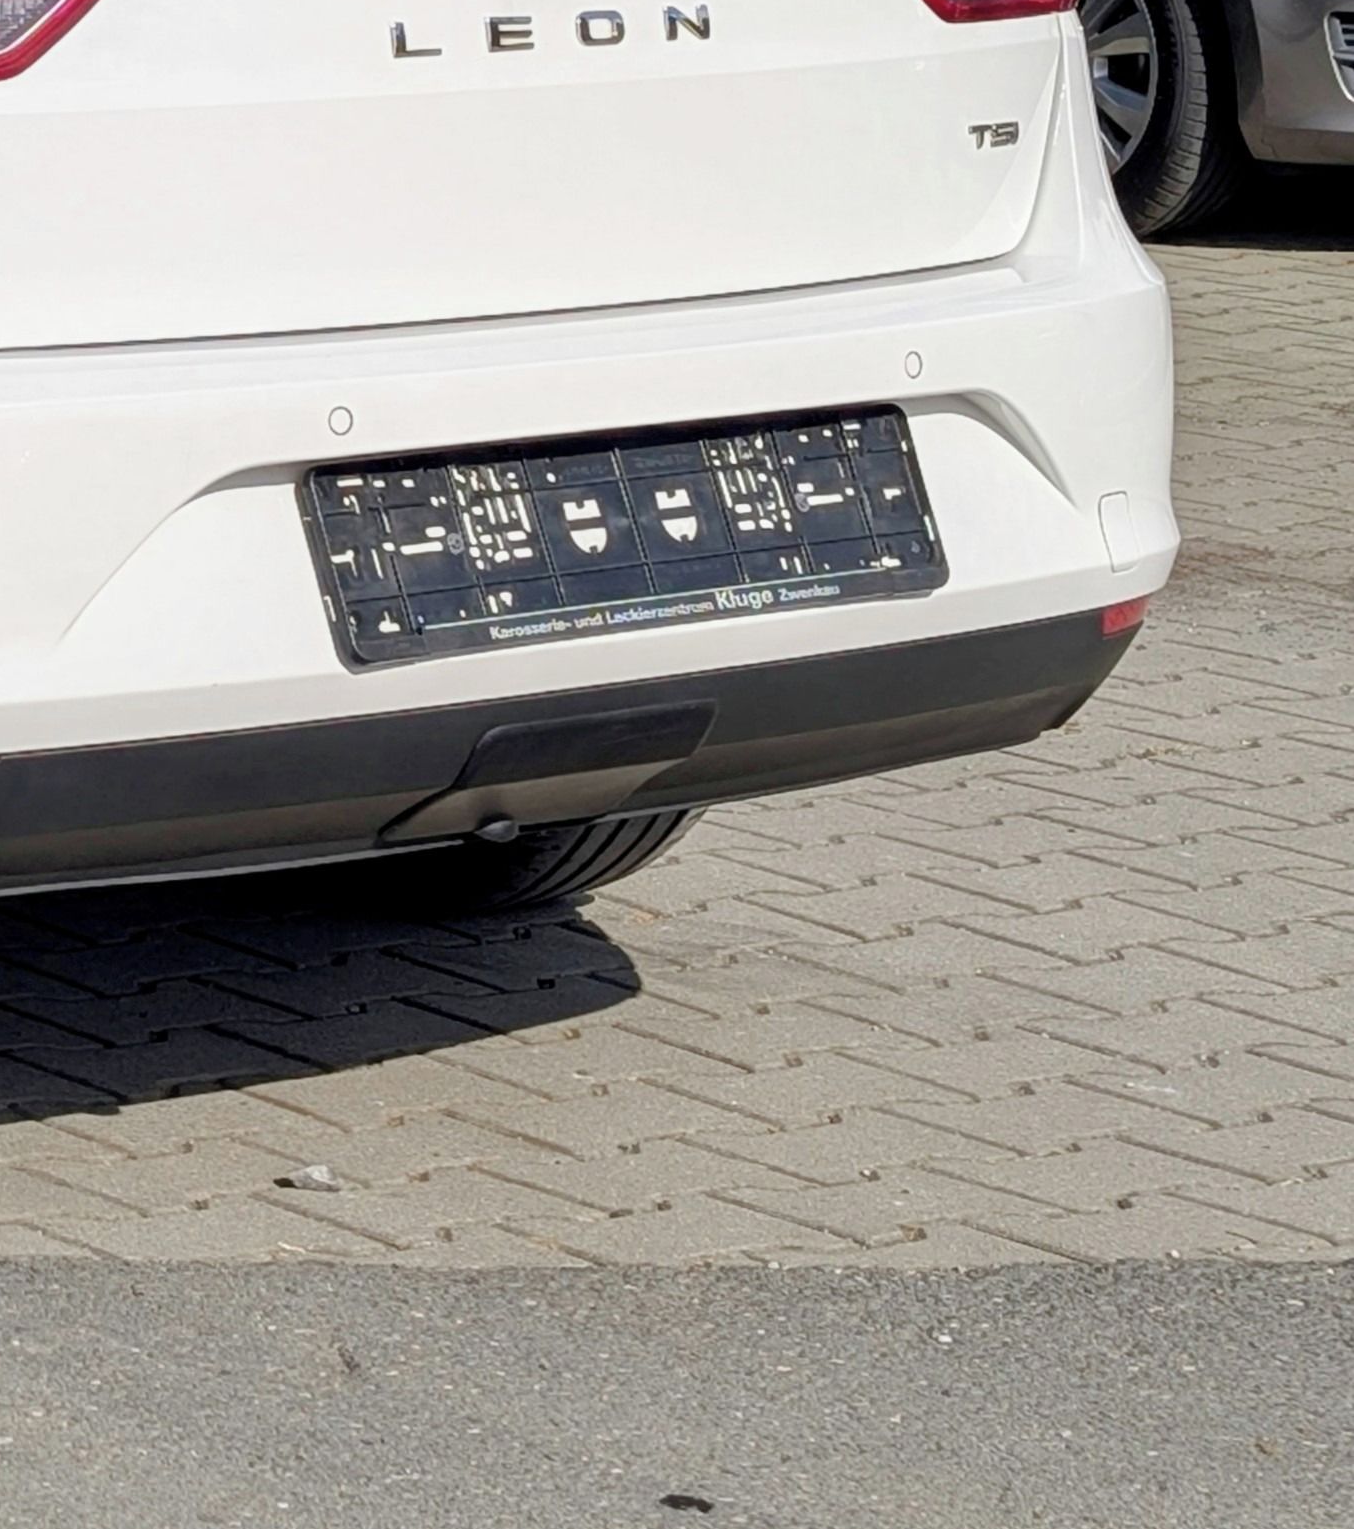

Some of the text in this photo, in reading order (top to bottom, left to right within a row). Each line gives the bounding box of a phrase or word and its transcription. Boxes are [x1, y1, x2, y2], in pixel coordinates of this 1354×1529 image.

[390, 4, 710, 58] LEON
[574, 612, 604, 629] und
[606, 600, 715, 625] Lackierzentrum
[714, 588, 774, 610] Kluge
[778, 583, 841, 602] Zwenkau
